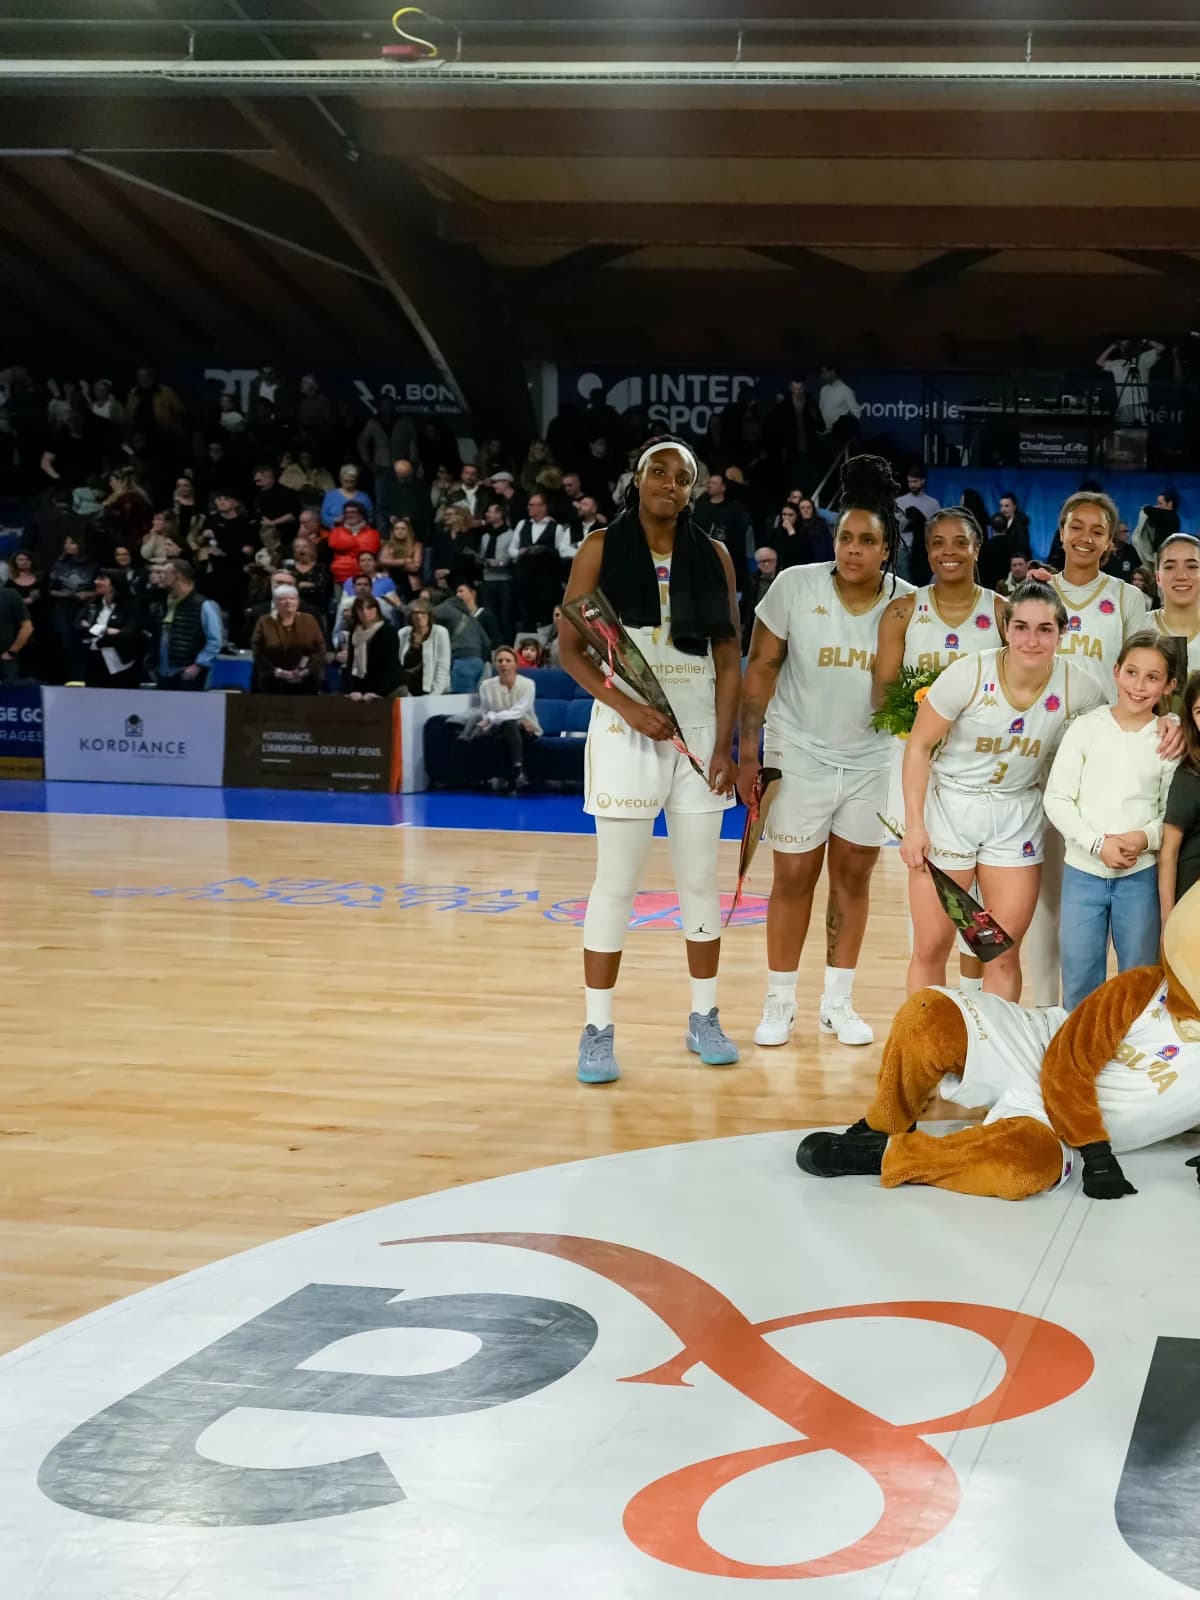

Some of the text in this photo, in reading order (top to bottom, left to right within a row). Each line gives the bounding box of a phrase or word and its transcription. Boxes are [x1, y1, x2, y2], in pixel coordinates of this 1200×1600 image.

[648, 404, 725, 434] SPO
[1056, 634, 1102, 660] LMA
[650, 662, 705, 675] ntpellier
[79, 738, 187, 755] KORDIANCE
[320, 745, 337, 755] QUI
[337, 746, 357, 756] FAIT
[358, 747, 384, 757] SENS.
[975, 736, 1042, 758] BLMA
[989, 760, 1009, 784] 3
[615, 798, 659, 808] VEOLIA
[1115, 1043, 1178, 1095] BLMA
